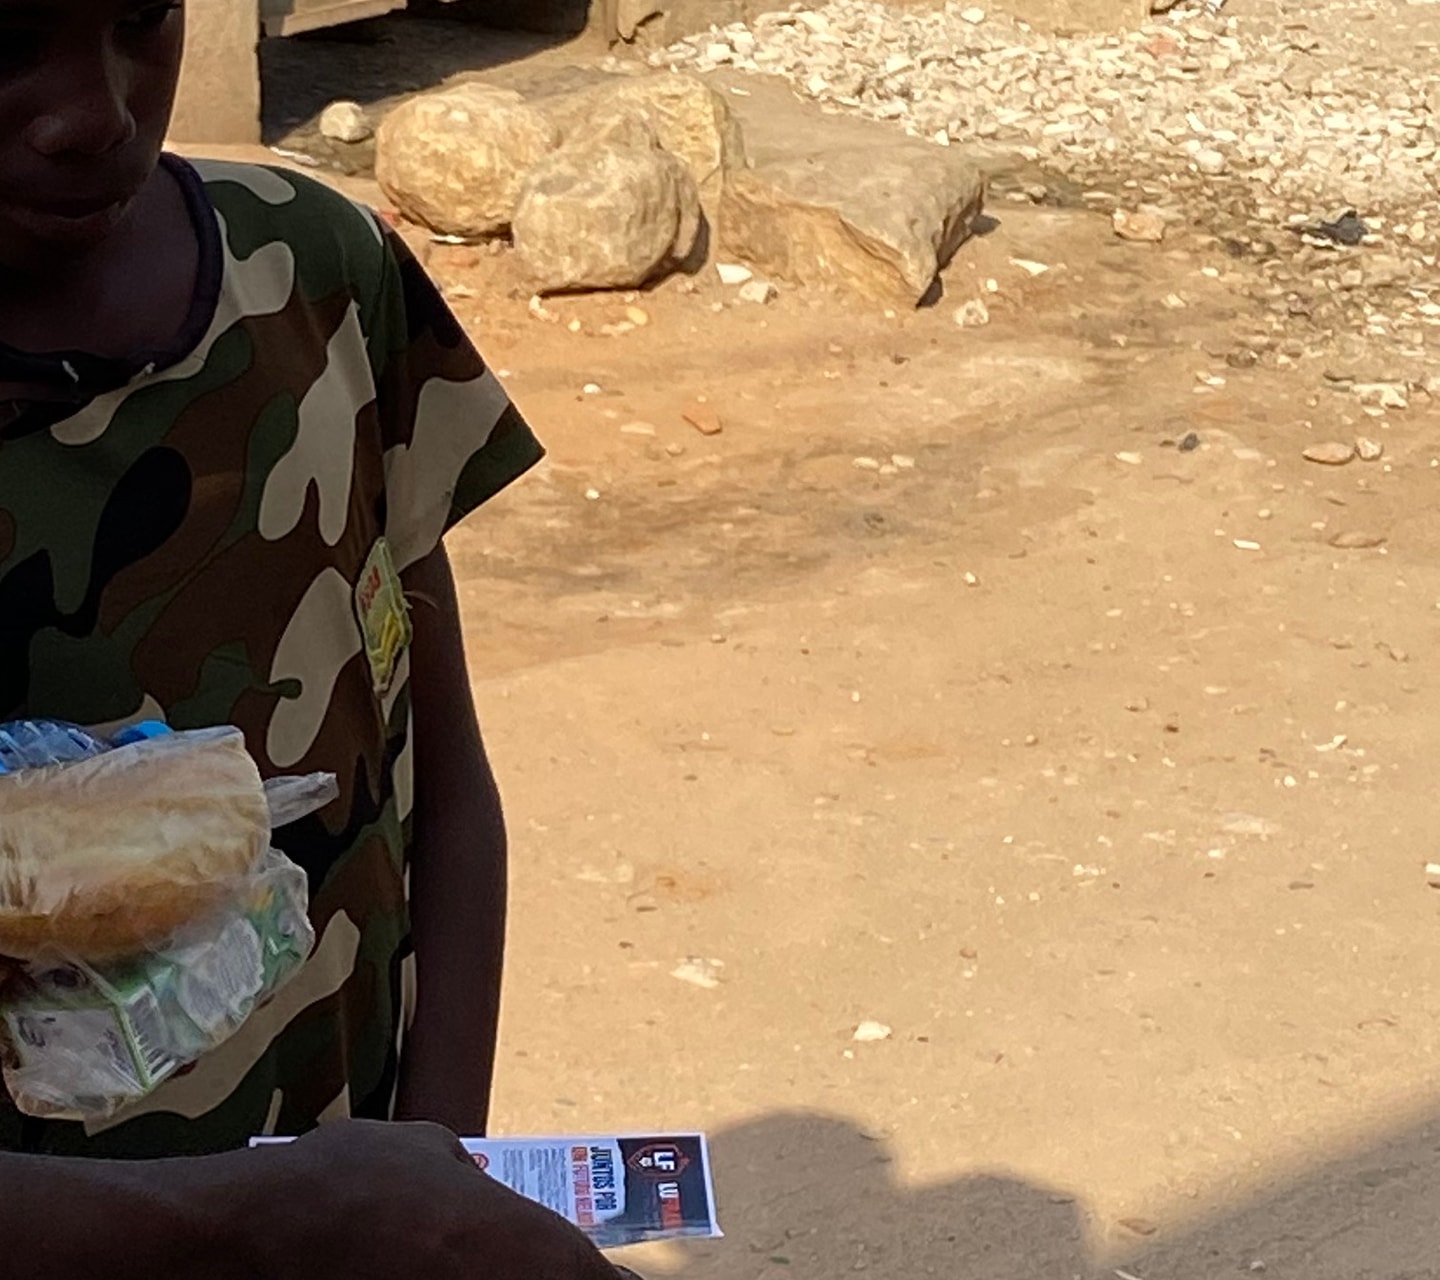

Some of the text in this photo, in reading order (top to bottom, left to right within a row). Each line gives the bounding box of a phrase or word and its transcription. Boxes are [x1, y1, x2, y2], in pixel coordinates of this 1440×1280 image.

[590, 1146, 618, 1211] JUNTOS POR
[653, 1151, 675, 1171] LF
